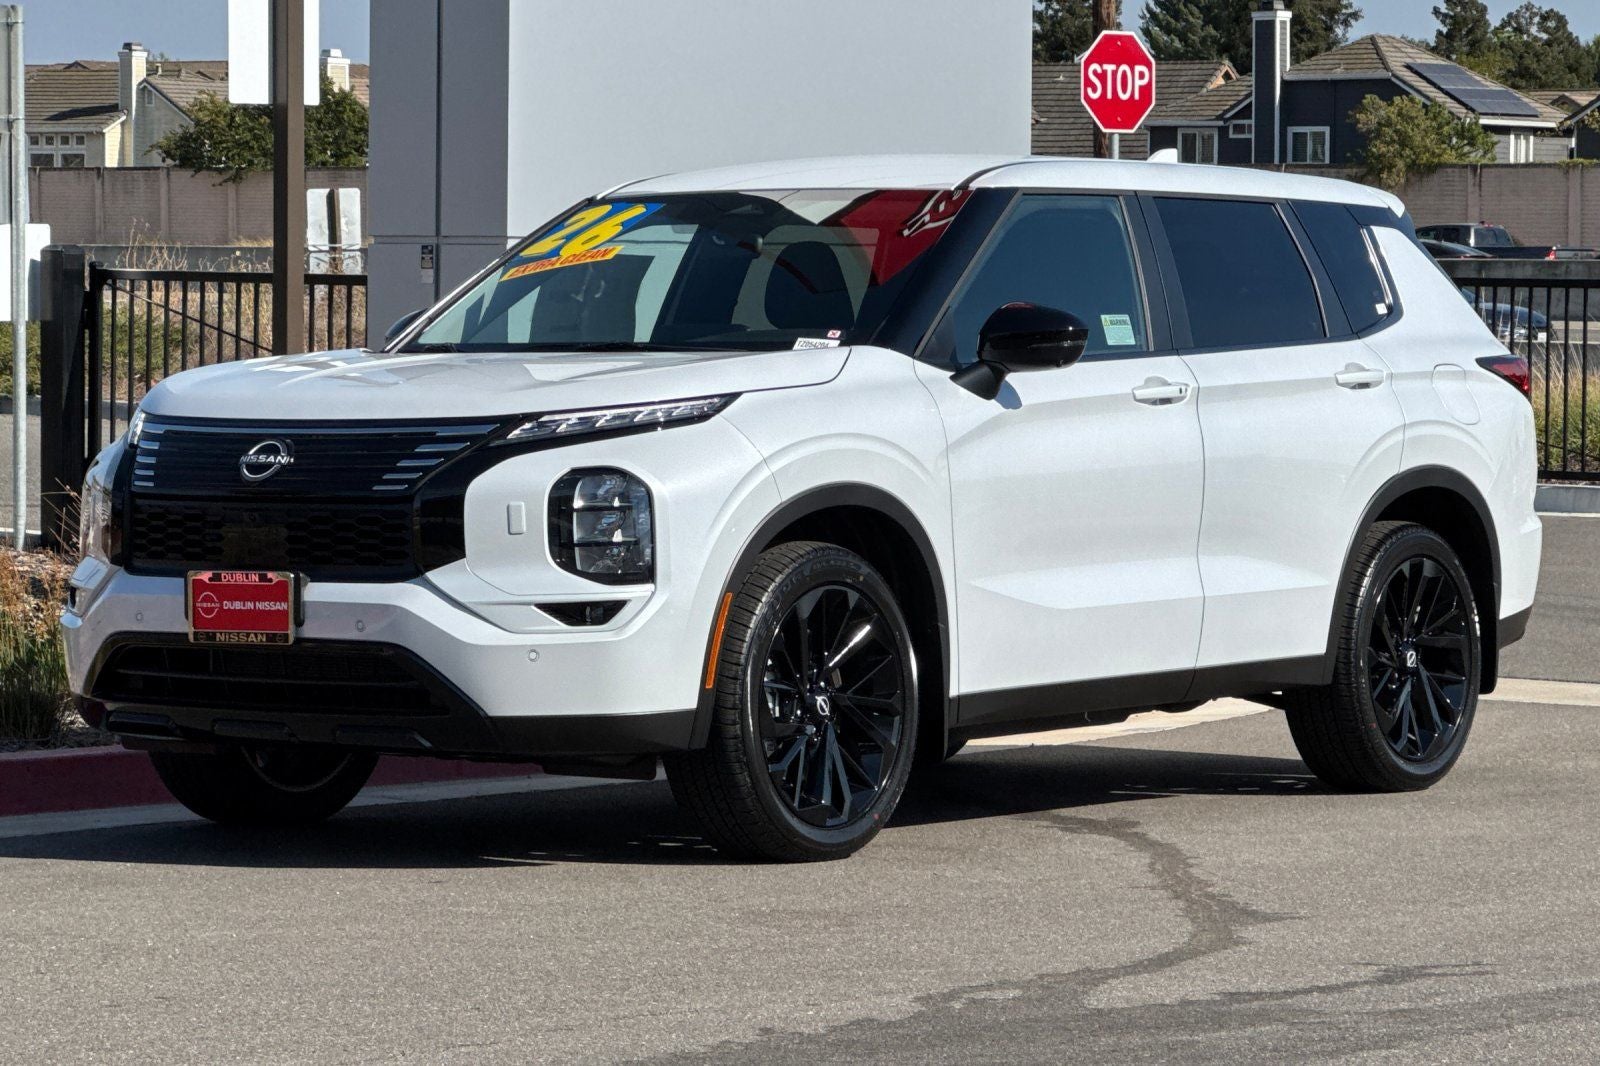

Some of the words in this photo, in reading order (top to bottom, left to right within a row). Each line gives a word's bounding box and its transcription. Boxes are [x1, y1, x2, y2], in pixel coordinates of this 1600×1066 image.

[1086, 62, 1150, 101] STOP
[519, 204, 647, 258] 26
[559, 247, 617, 265] CLEAN
[240, 454, 288, 465] NISSAN
[221, 572, 260, 582] DUBLIN
[222, 600, 254, 610] DUBLIN
[255, 601, 288, 611] NISSAN
[215, 631, 267, 642] NISSAN
